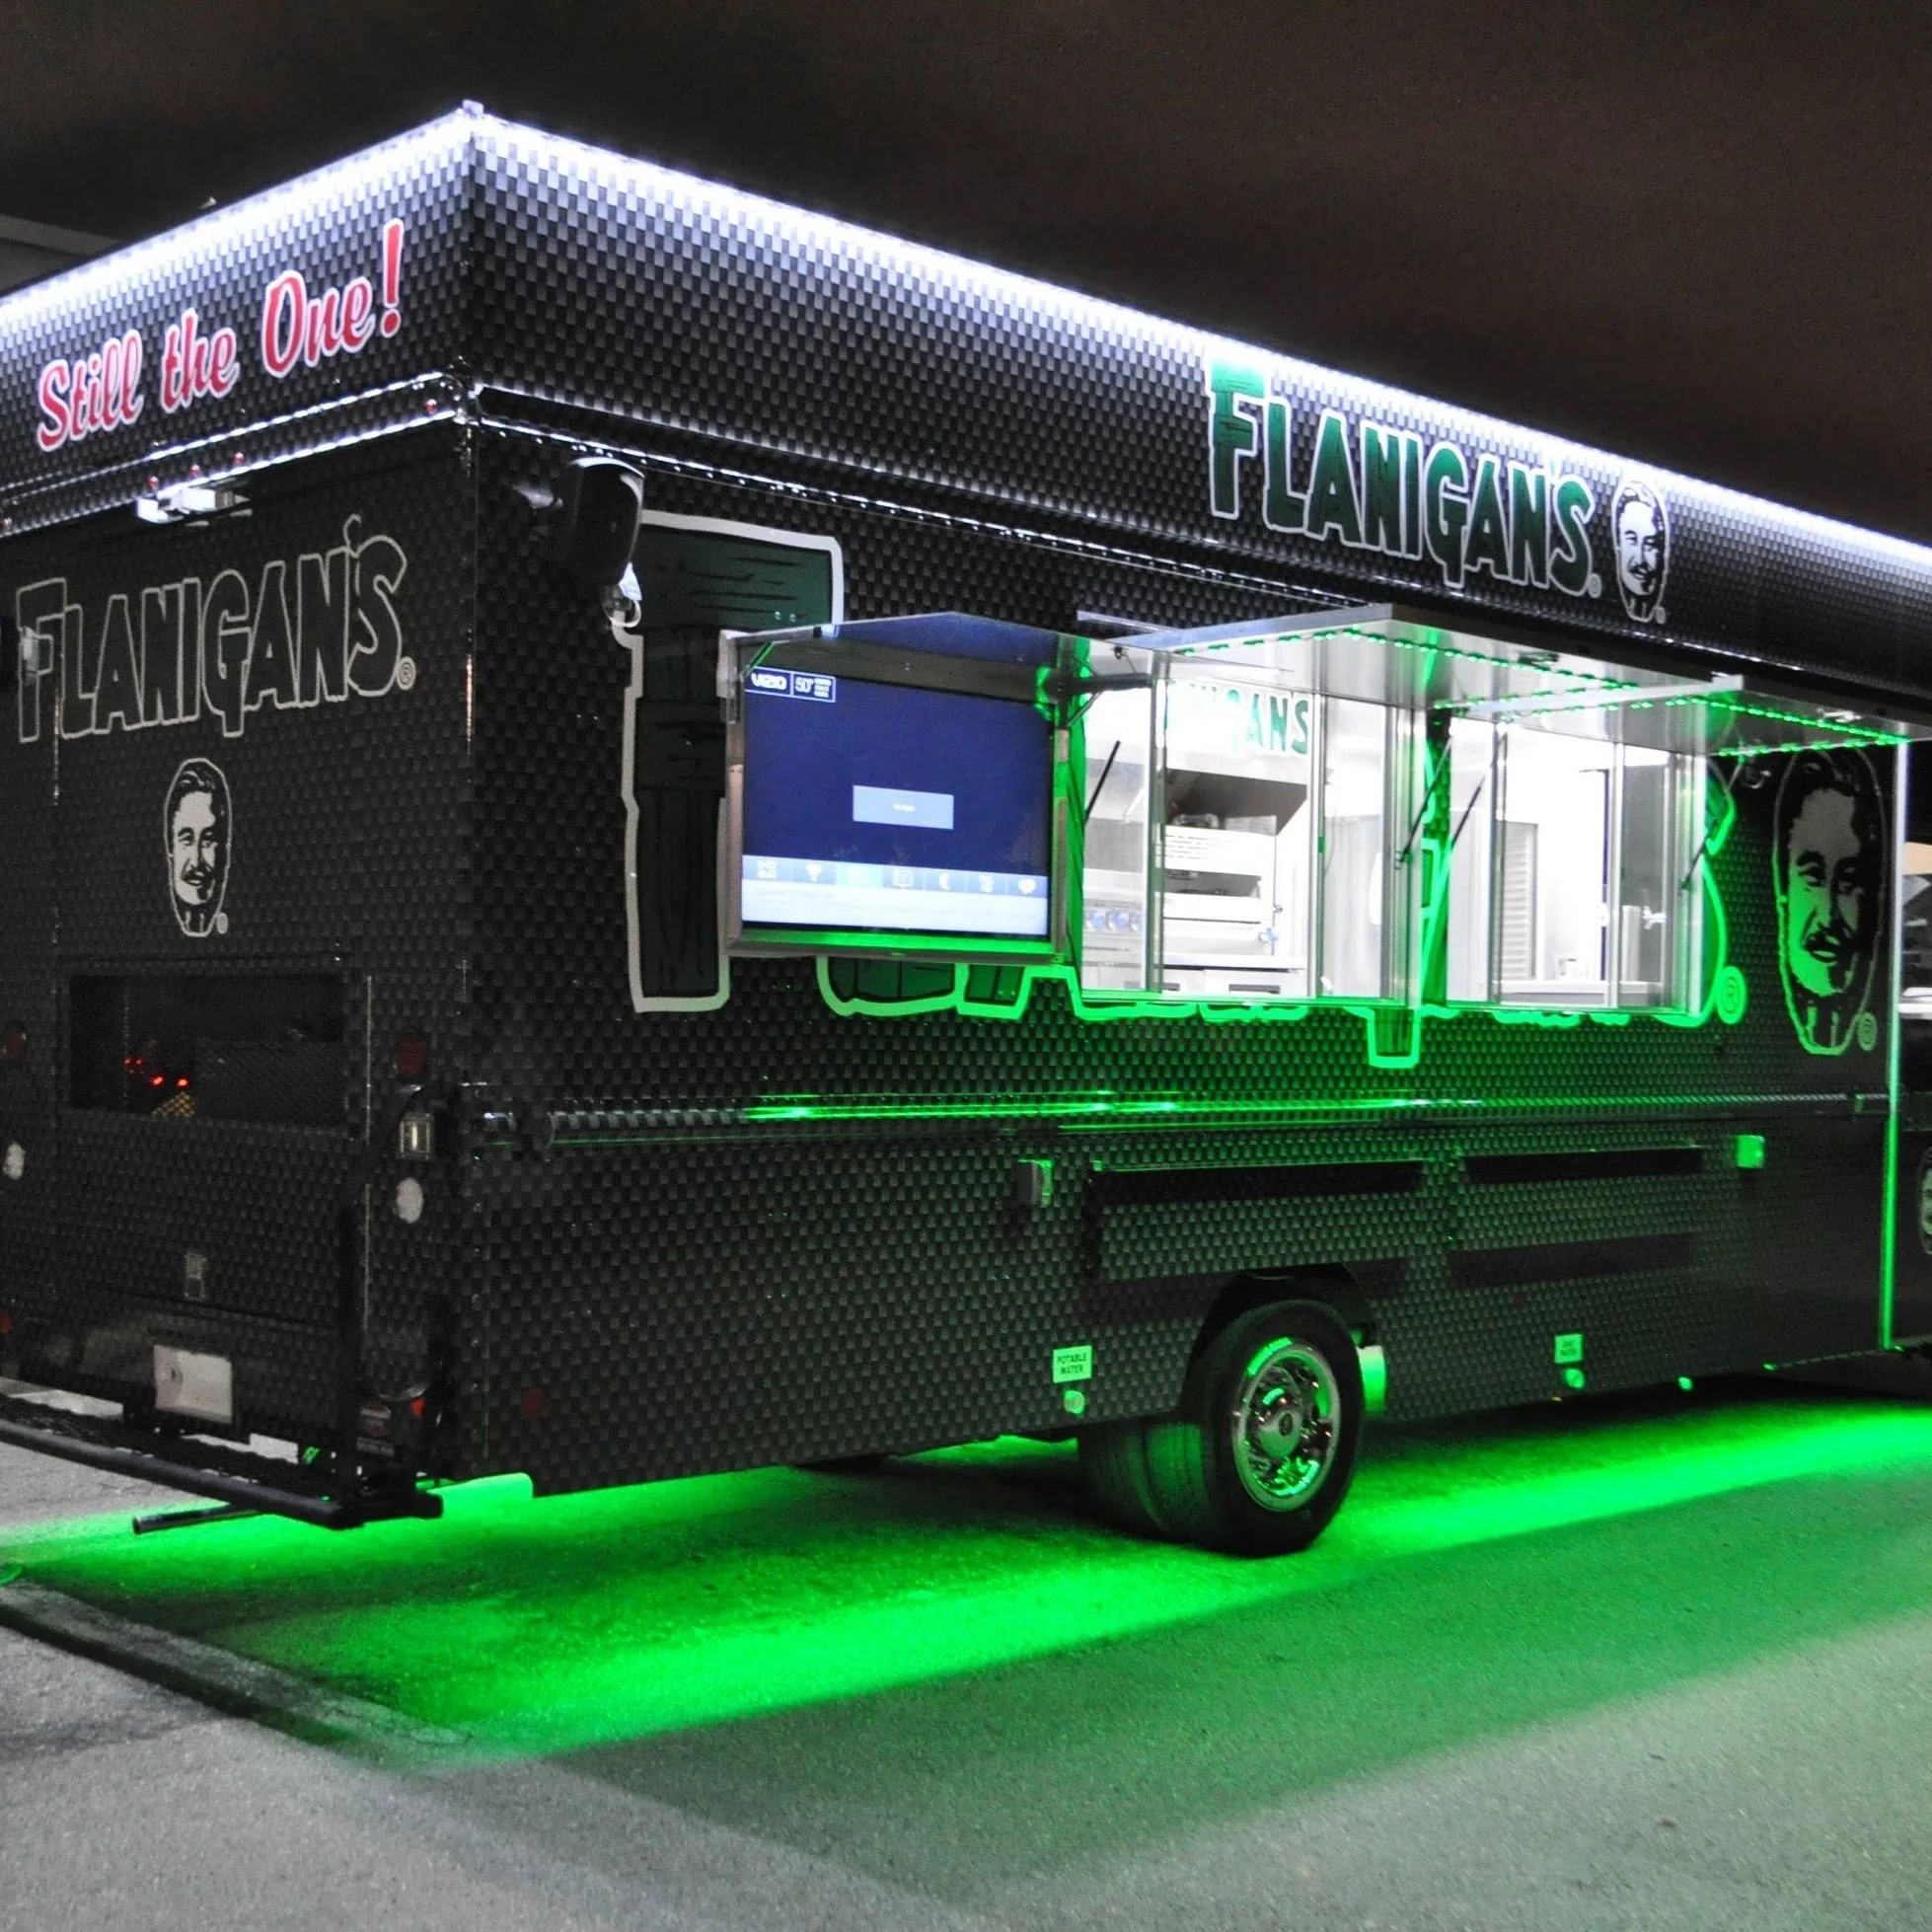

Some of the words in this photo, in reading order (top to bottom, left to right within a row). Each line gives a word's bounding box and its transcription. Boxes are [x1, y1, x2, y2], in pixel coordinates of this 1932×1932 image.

[37, 329, 143, 452] Still
[160, 308, 240, 413] the
[261, 218, 405, 379] One!
[1203, 357, 1596, 598] FLANIGAN'S
